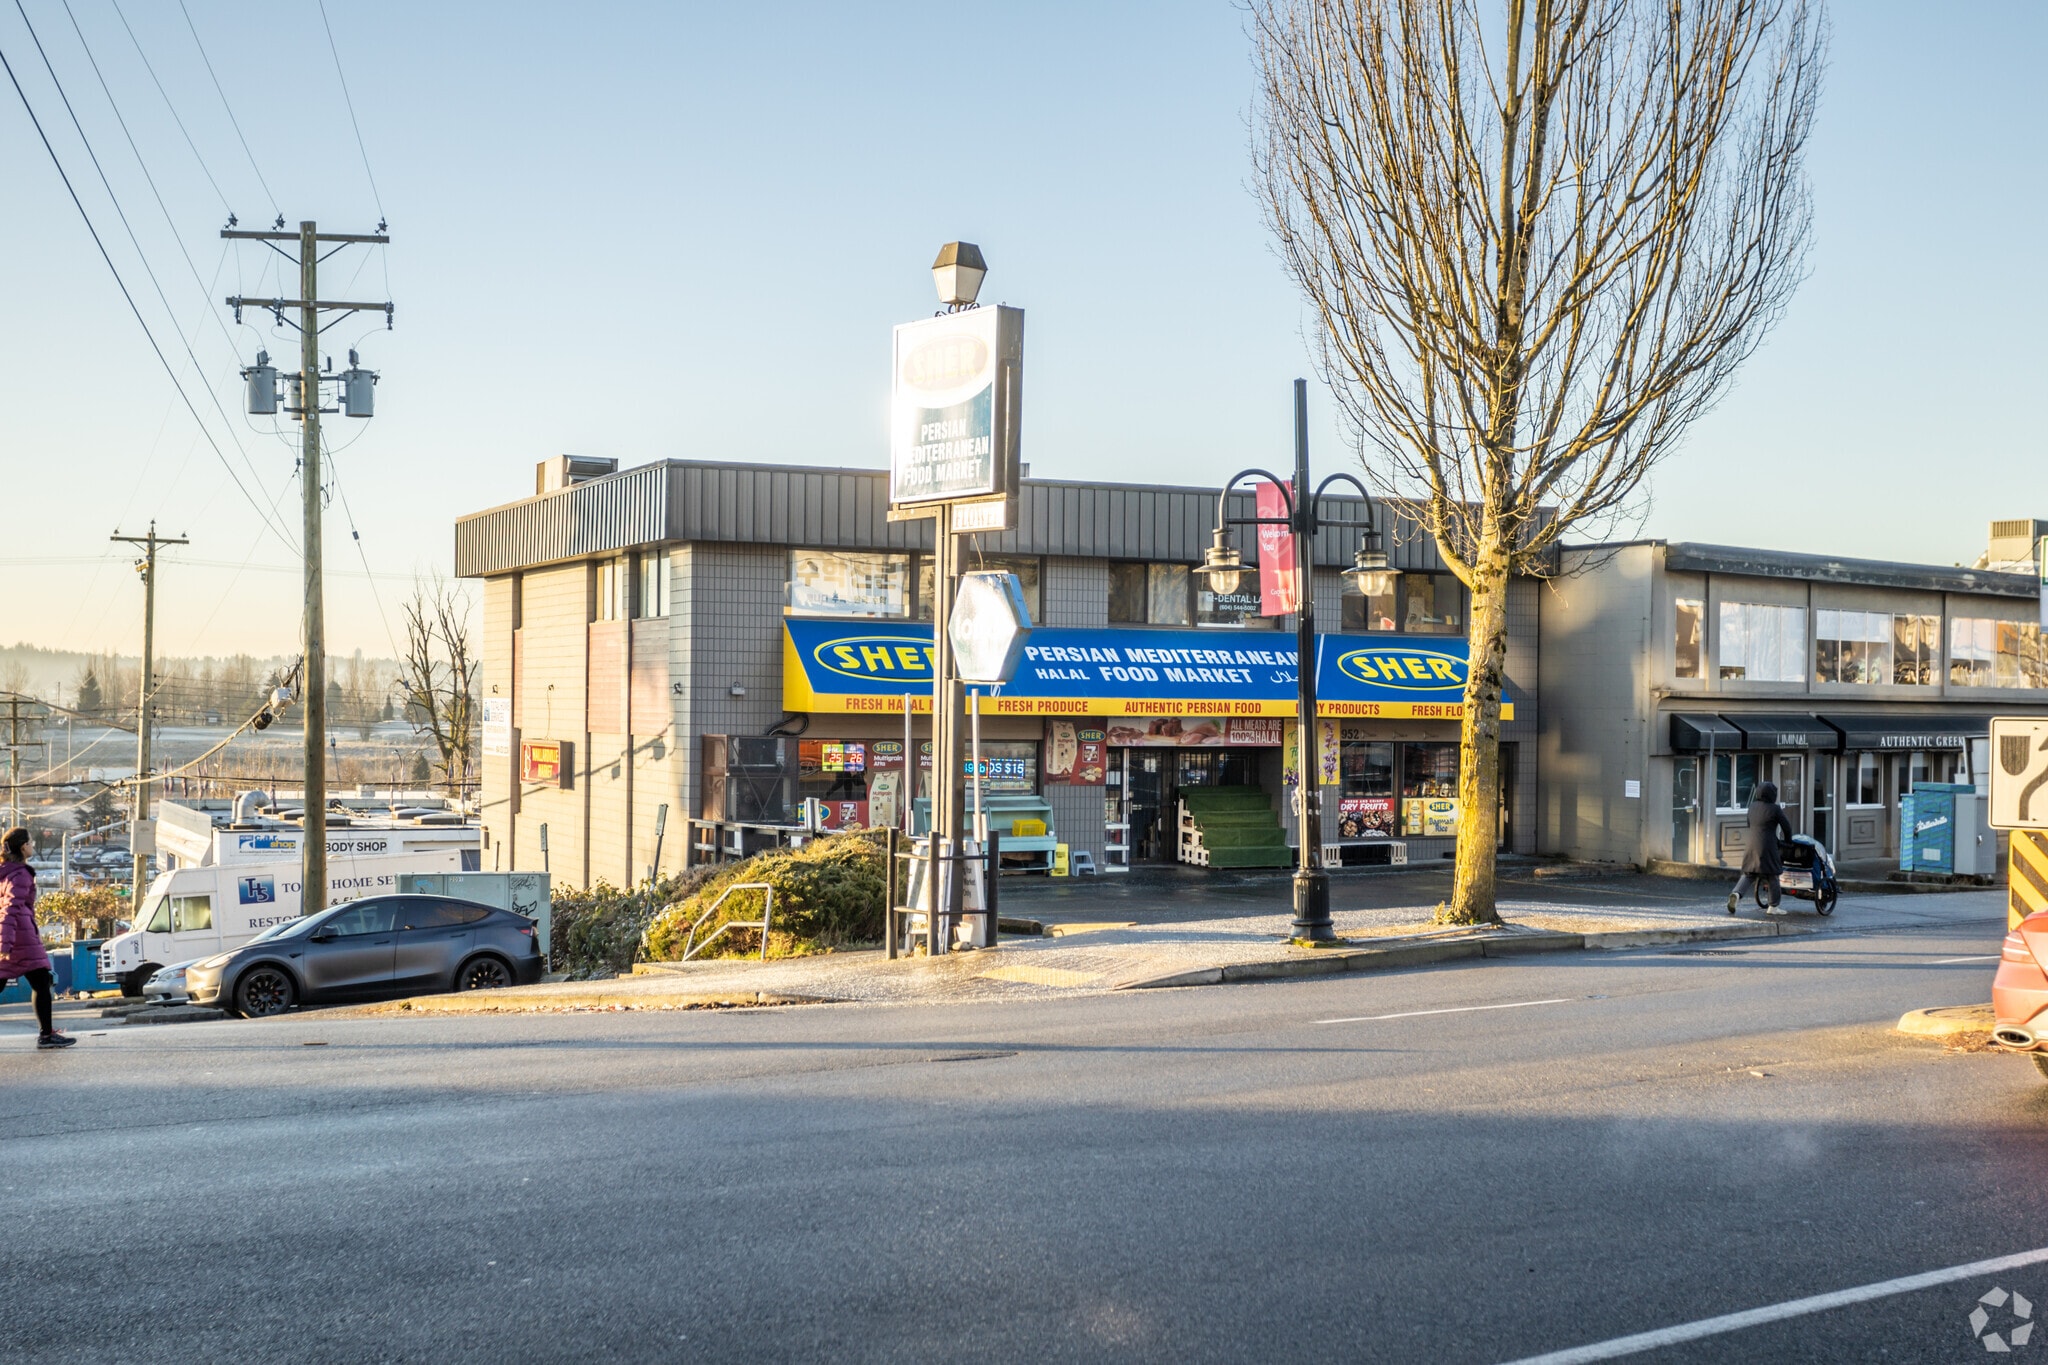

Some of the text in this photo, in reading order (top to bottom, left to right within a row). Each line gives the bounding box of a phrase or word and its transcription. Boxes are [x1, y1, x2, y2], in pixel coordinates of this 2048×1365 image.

[921, 419, 967, 442] PERSIAN
[906, 436, 989, 465] EDITERRANEAN
[904, 458, 982, 486] FOOD MARKET
[1262, 529, 1289, 539] Welcom
[1025, 646, 1298, 666] PERSIAN MEDITERRANEAN
[1035, 667, 1253, 683] HALAL FOOD MARKET
[1352, 656, 1462, 683] SHER
[846, 698, 883, 711] FRESH
[888, 698, 925, 711] HAAL
[998, 700, 1088, 712] FRESH PRODUCE
[1124, 701, 1262, 714] AUTHENTIC PERSIAN FOOD
[1328, 703, 1380, 715] PRODUCTS
[1412, 705, 1463, 717] FRESH FLO
[1231, 719, 1282, 731] ALL MEATS ARE
[1081, 732, 1102, 740] SHER
[1231, 731, 1281, 743] 100% HALAL
[1341, 728, 1360, 740] 952
[876, 742, 899, 752] SHER
[1880, 735, 1933, 747] AUTHENTIC
[829, 753, 842, 763] 25
[849, 753, 863, 763] 26
[873, 755, 903, 763] Multigrain
[1004, 763, 1024, 774] $15
[1360, 802, 1388, 810] FRUITS
[1431, 803, 1451, 811] SHER
[270, 839, 296, 849] shop
[326, 841, 387, 852] BODY SHOP
[282, 875, 396, 893] TO HOME SE
